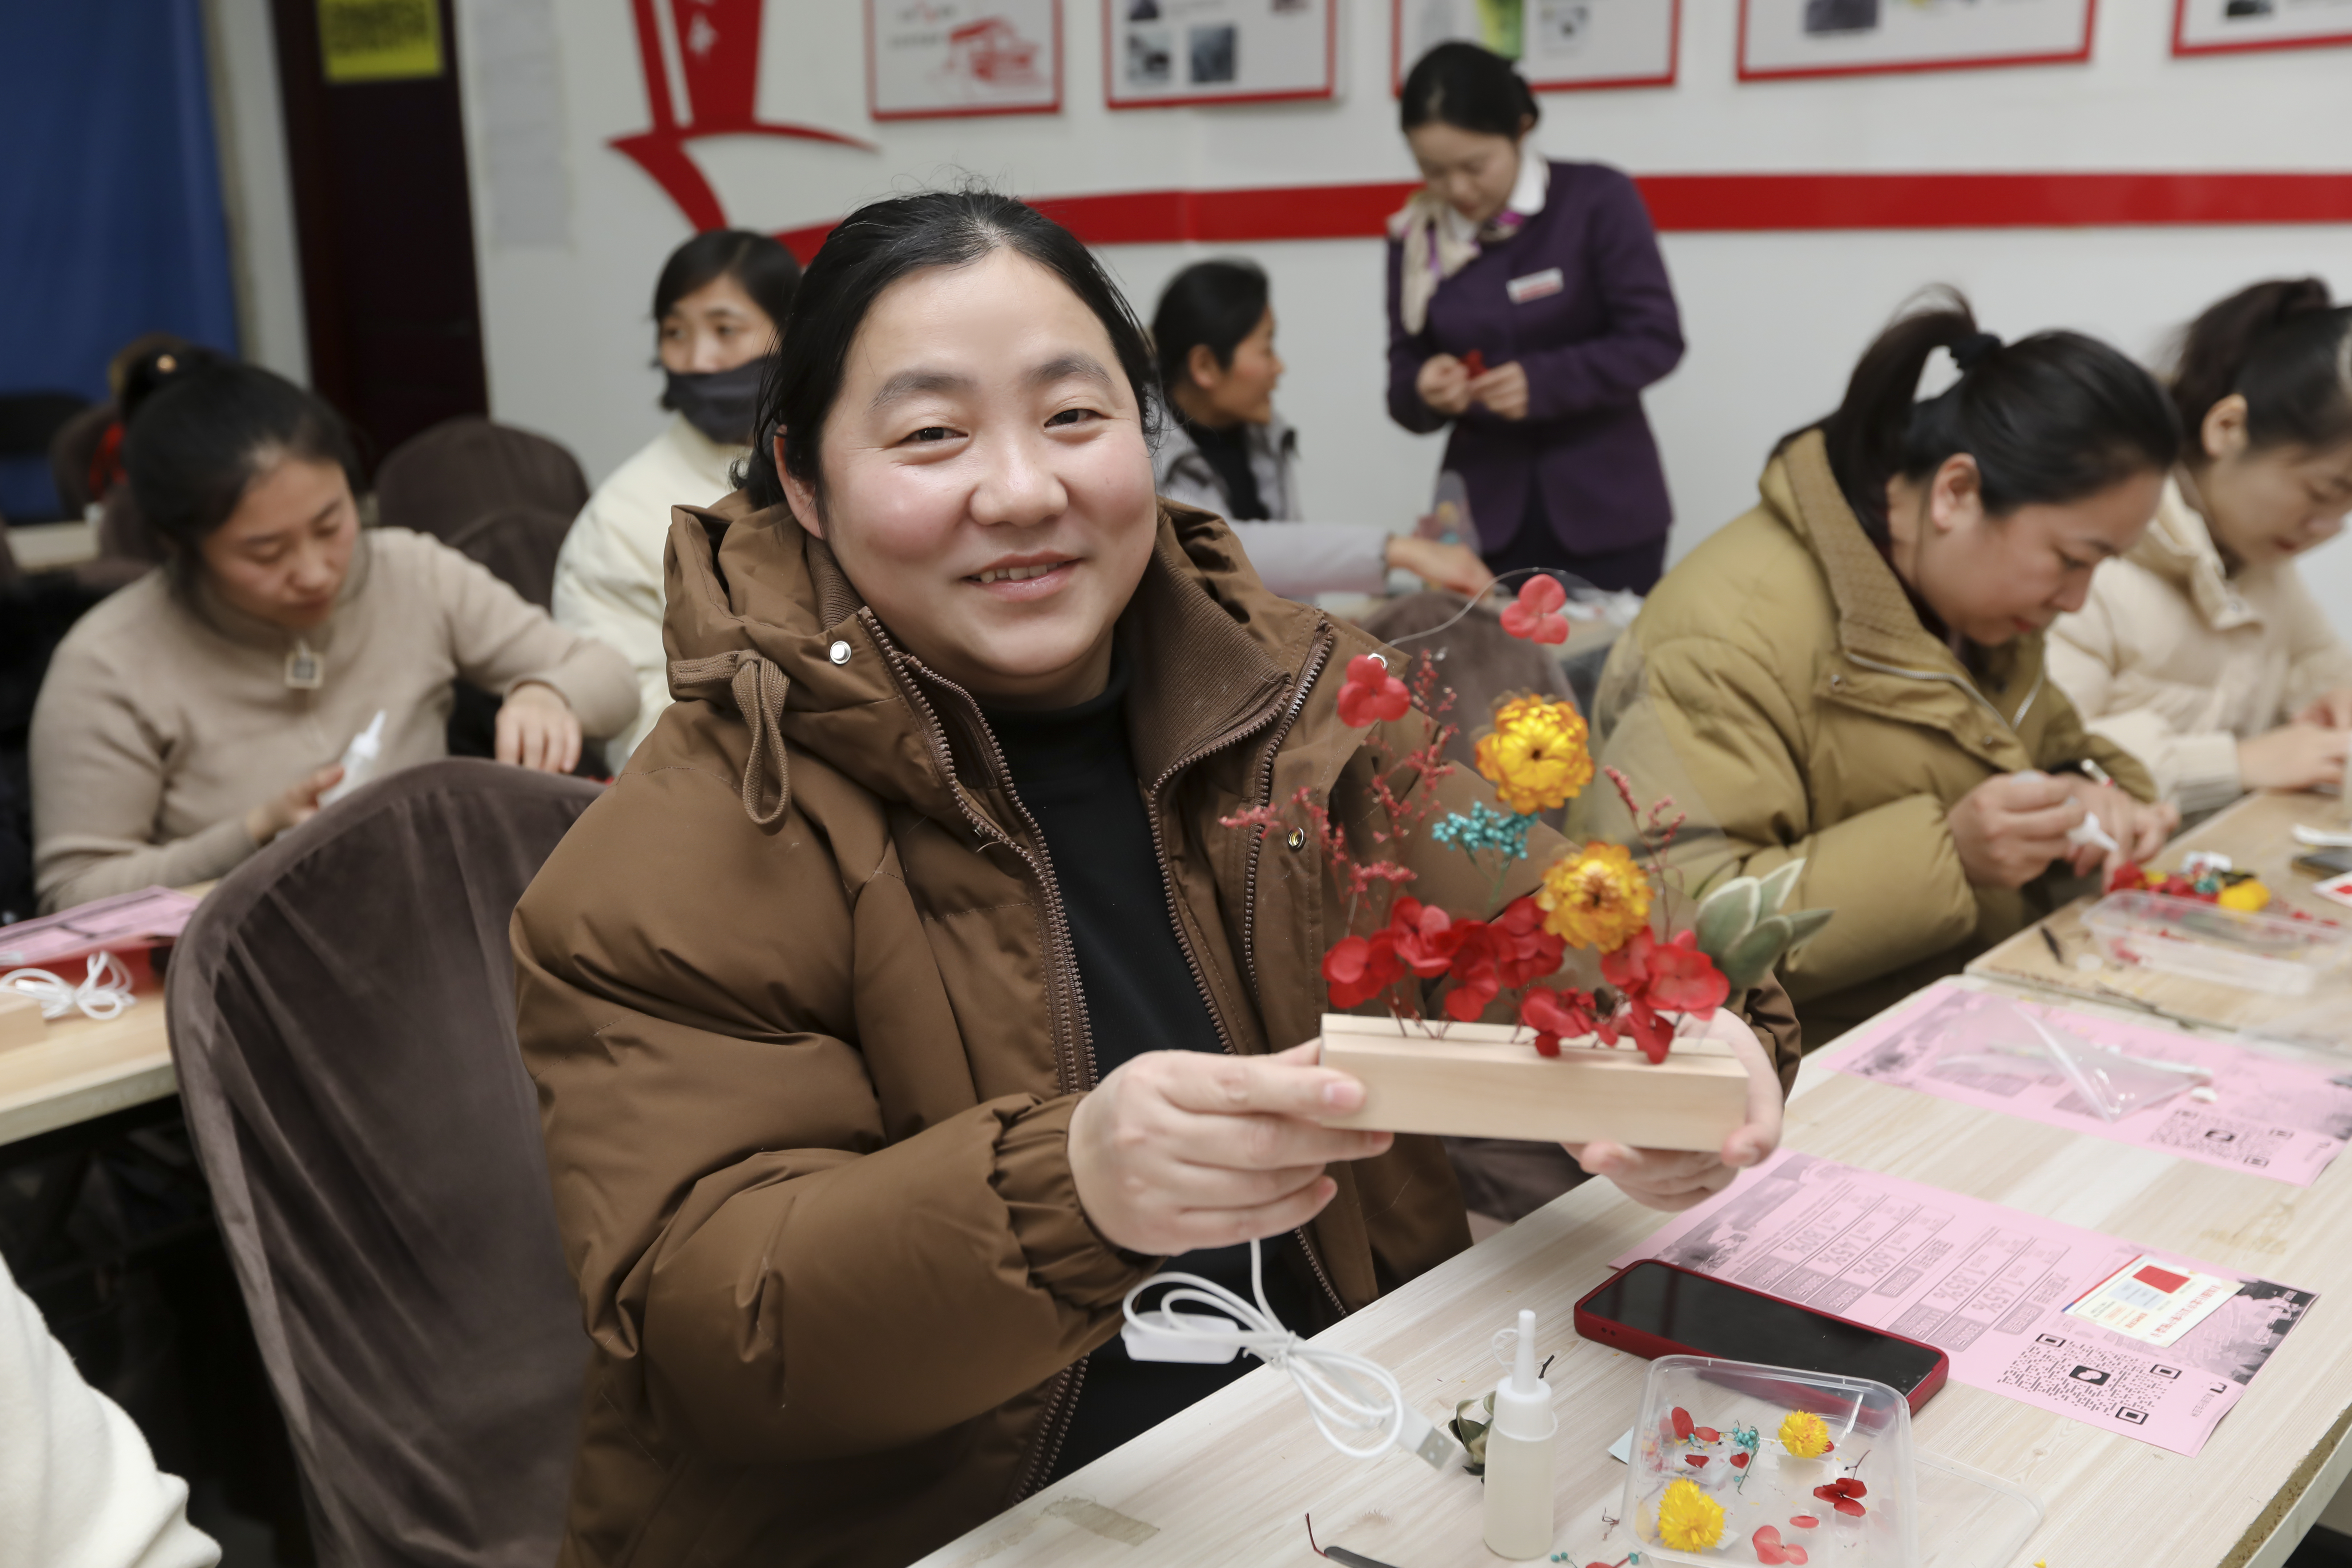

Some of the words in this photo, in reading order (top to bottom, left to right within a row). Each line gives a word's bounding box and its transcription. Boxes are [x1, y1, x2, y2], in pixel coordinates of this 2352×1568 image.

[1781, 1220, 1840, 1256] 1.80%
[1815, 1231, 1875, 1268] 1.45%
[1851, 1242, 1911, 1279] 1.60%
[1931, 1265, 1990, 1303] 1.85%
[1969, 1276, 2028, 1315] 1.65%
